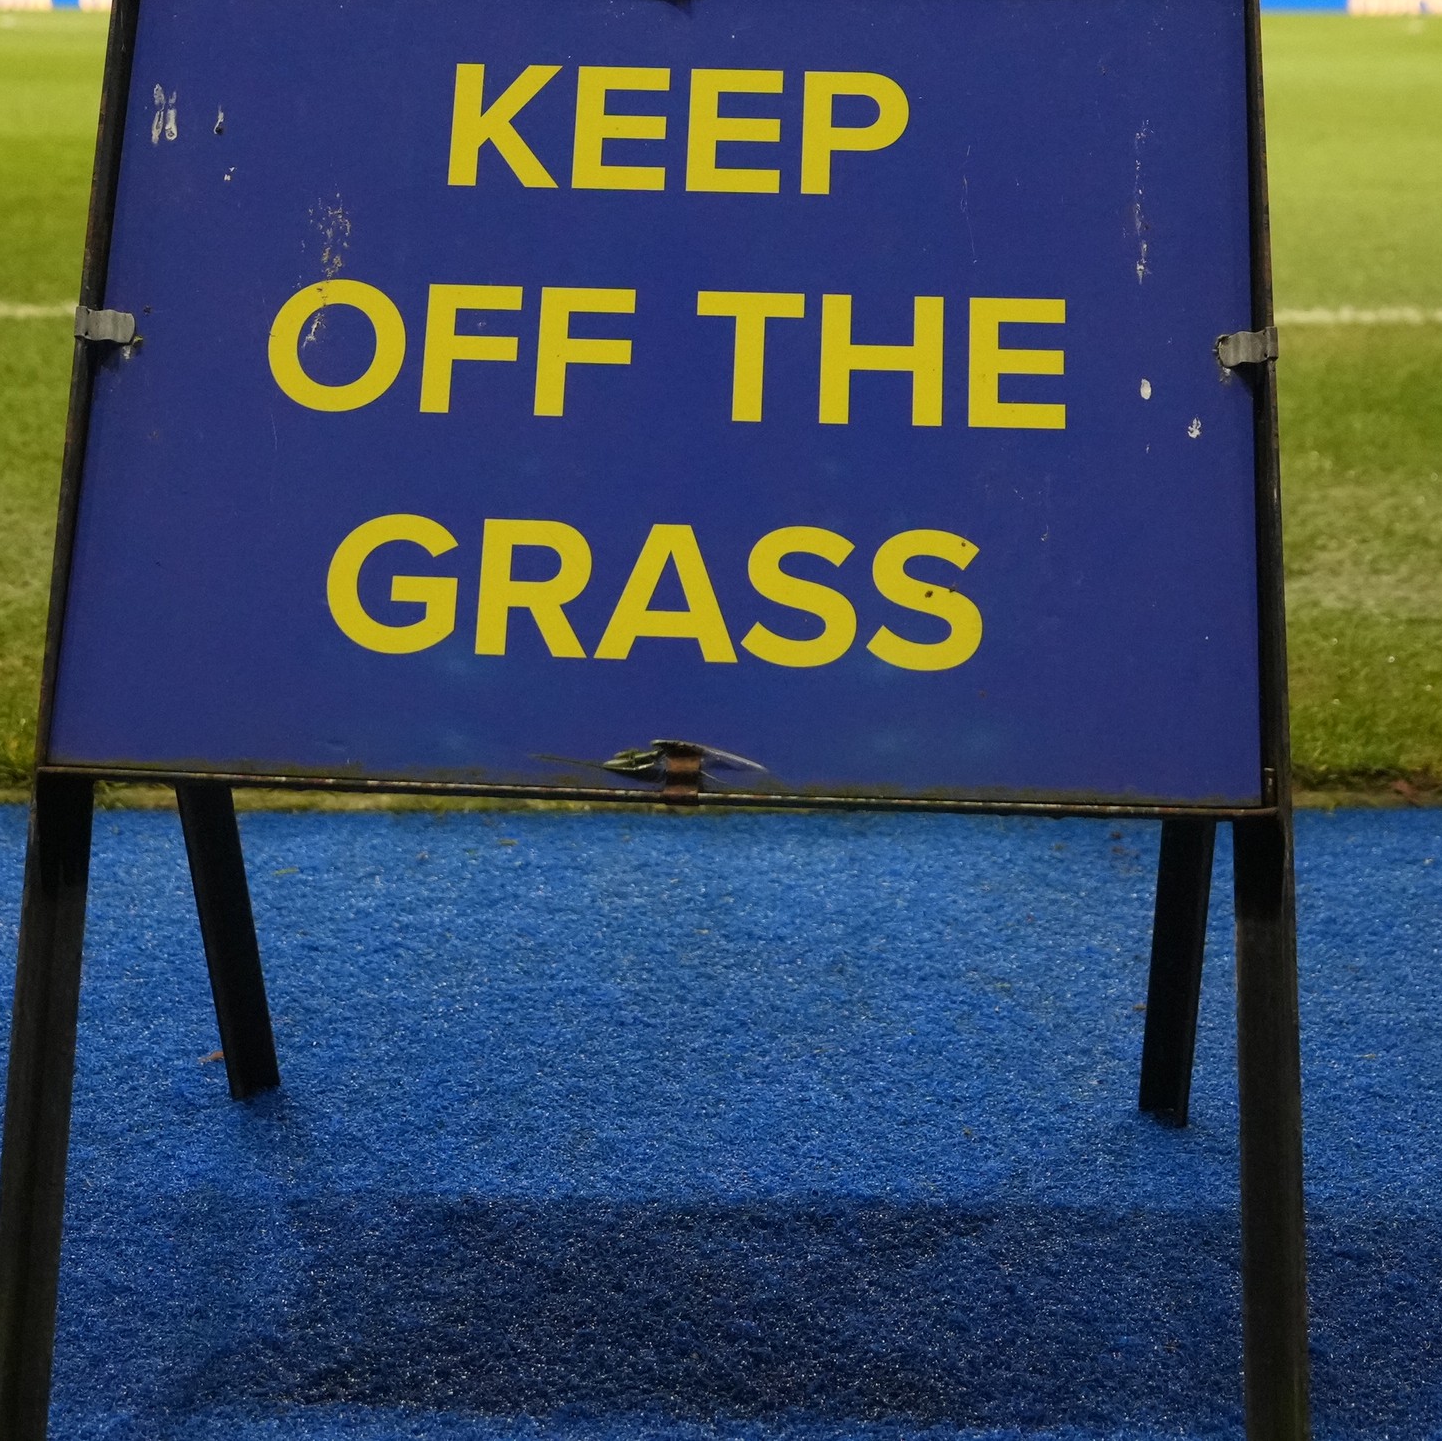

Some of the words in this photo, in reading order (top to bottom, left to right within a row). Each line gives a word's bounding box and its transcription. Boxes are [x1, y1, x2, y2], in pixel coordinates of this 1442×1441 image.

[448, 63, 909, 195] KEEP
[268, 279, 636, 417] OFF
[697, 291, 1066, 429] THE
[327, 513, 983, 671] GRASS
